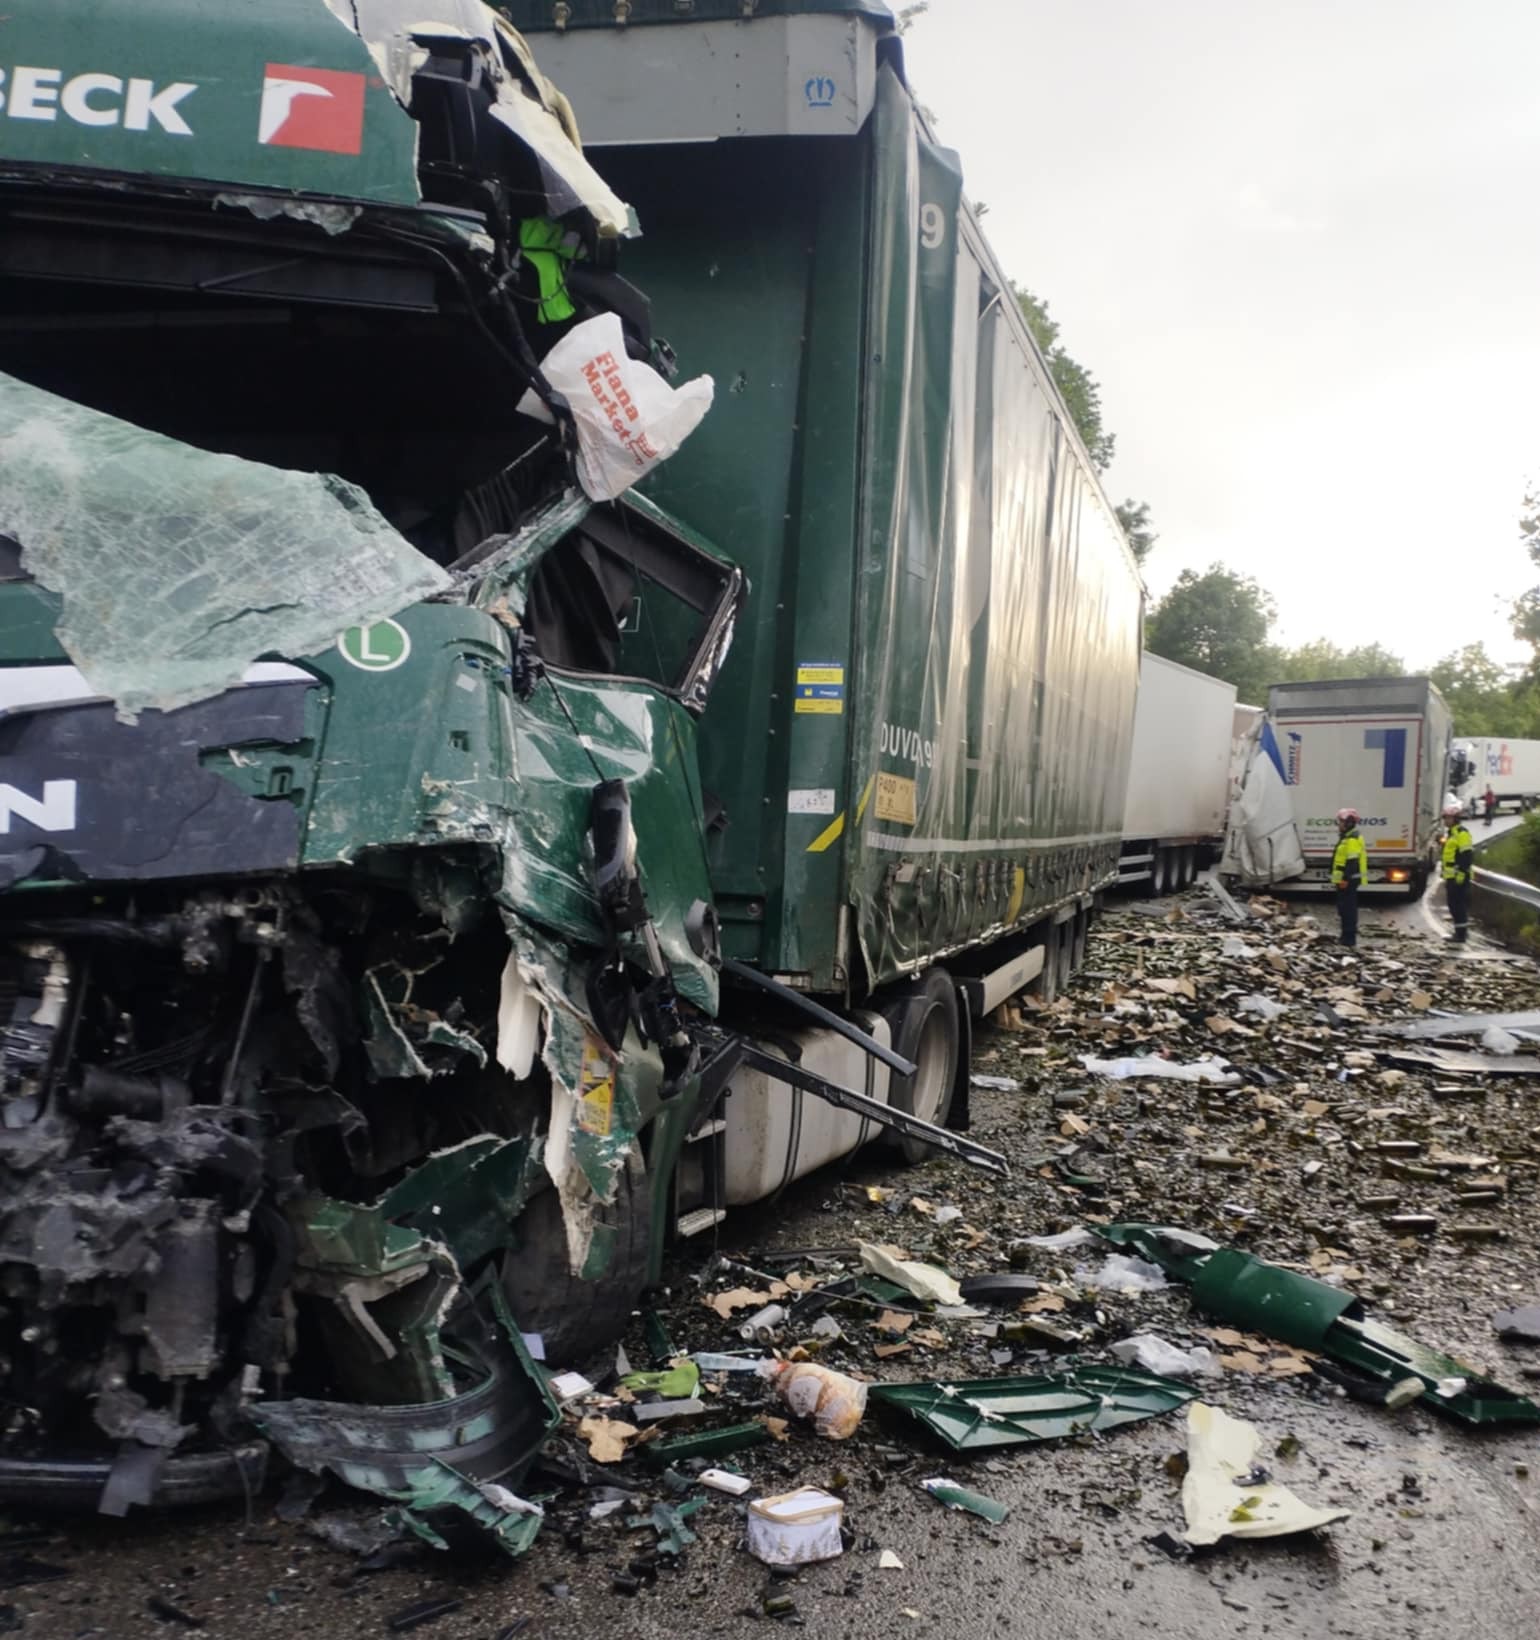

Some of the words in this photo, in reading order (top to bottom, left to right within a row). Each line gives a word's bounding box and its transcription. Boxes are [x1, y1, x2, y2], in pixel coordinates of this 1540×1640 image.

[0, 66, 198, 136] ECK
[920, 202, 946, 249] 9
[580, 361, 632, 442] Market
[595, 350, 639, 423] Flana
